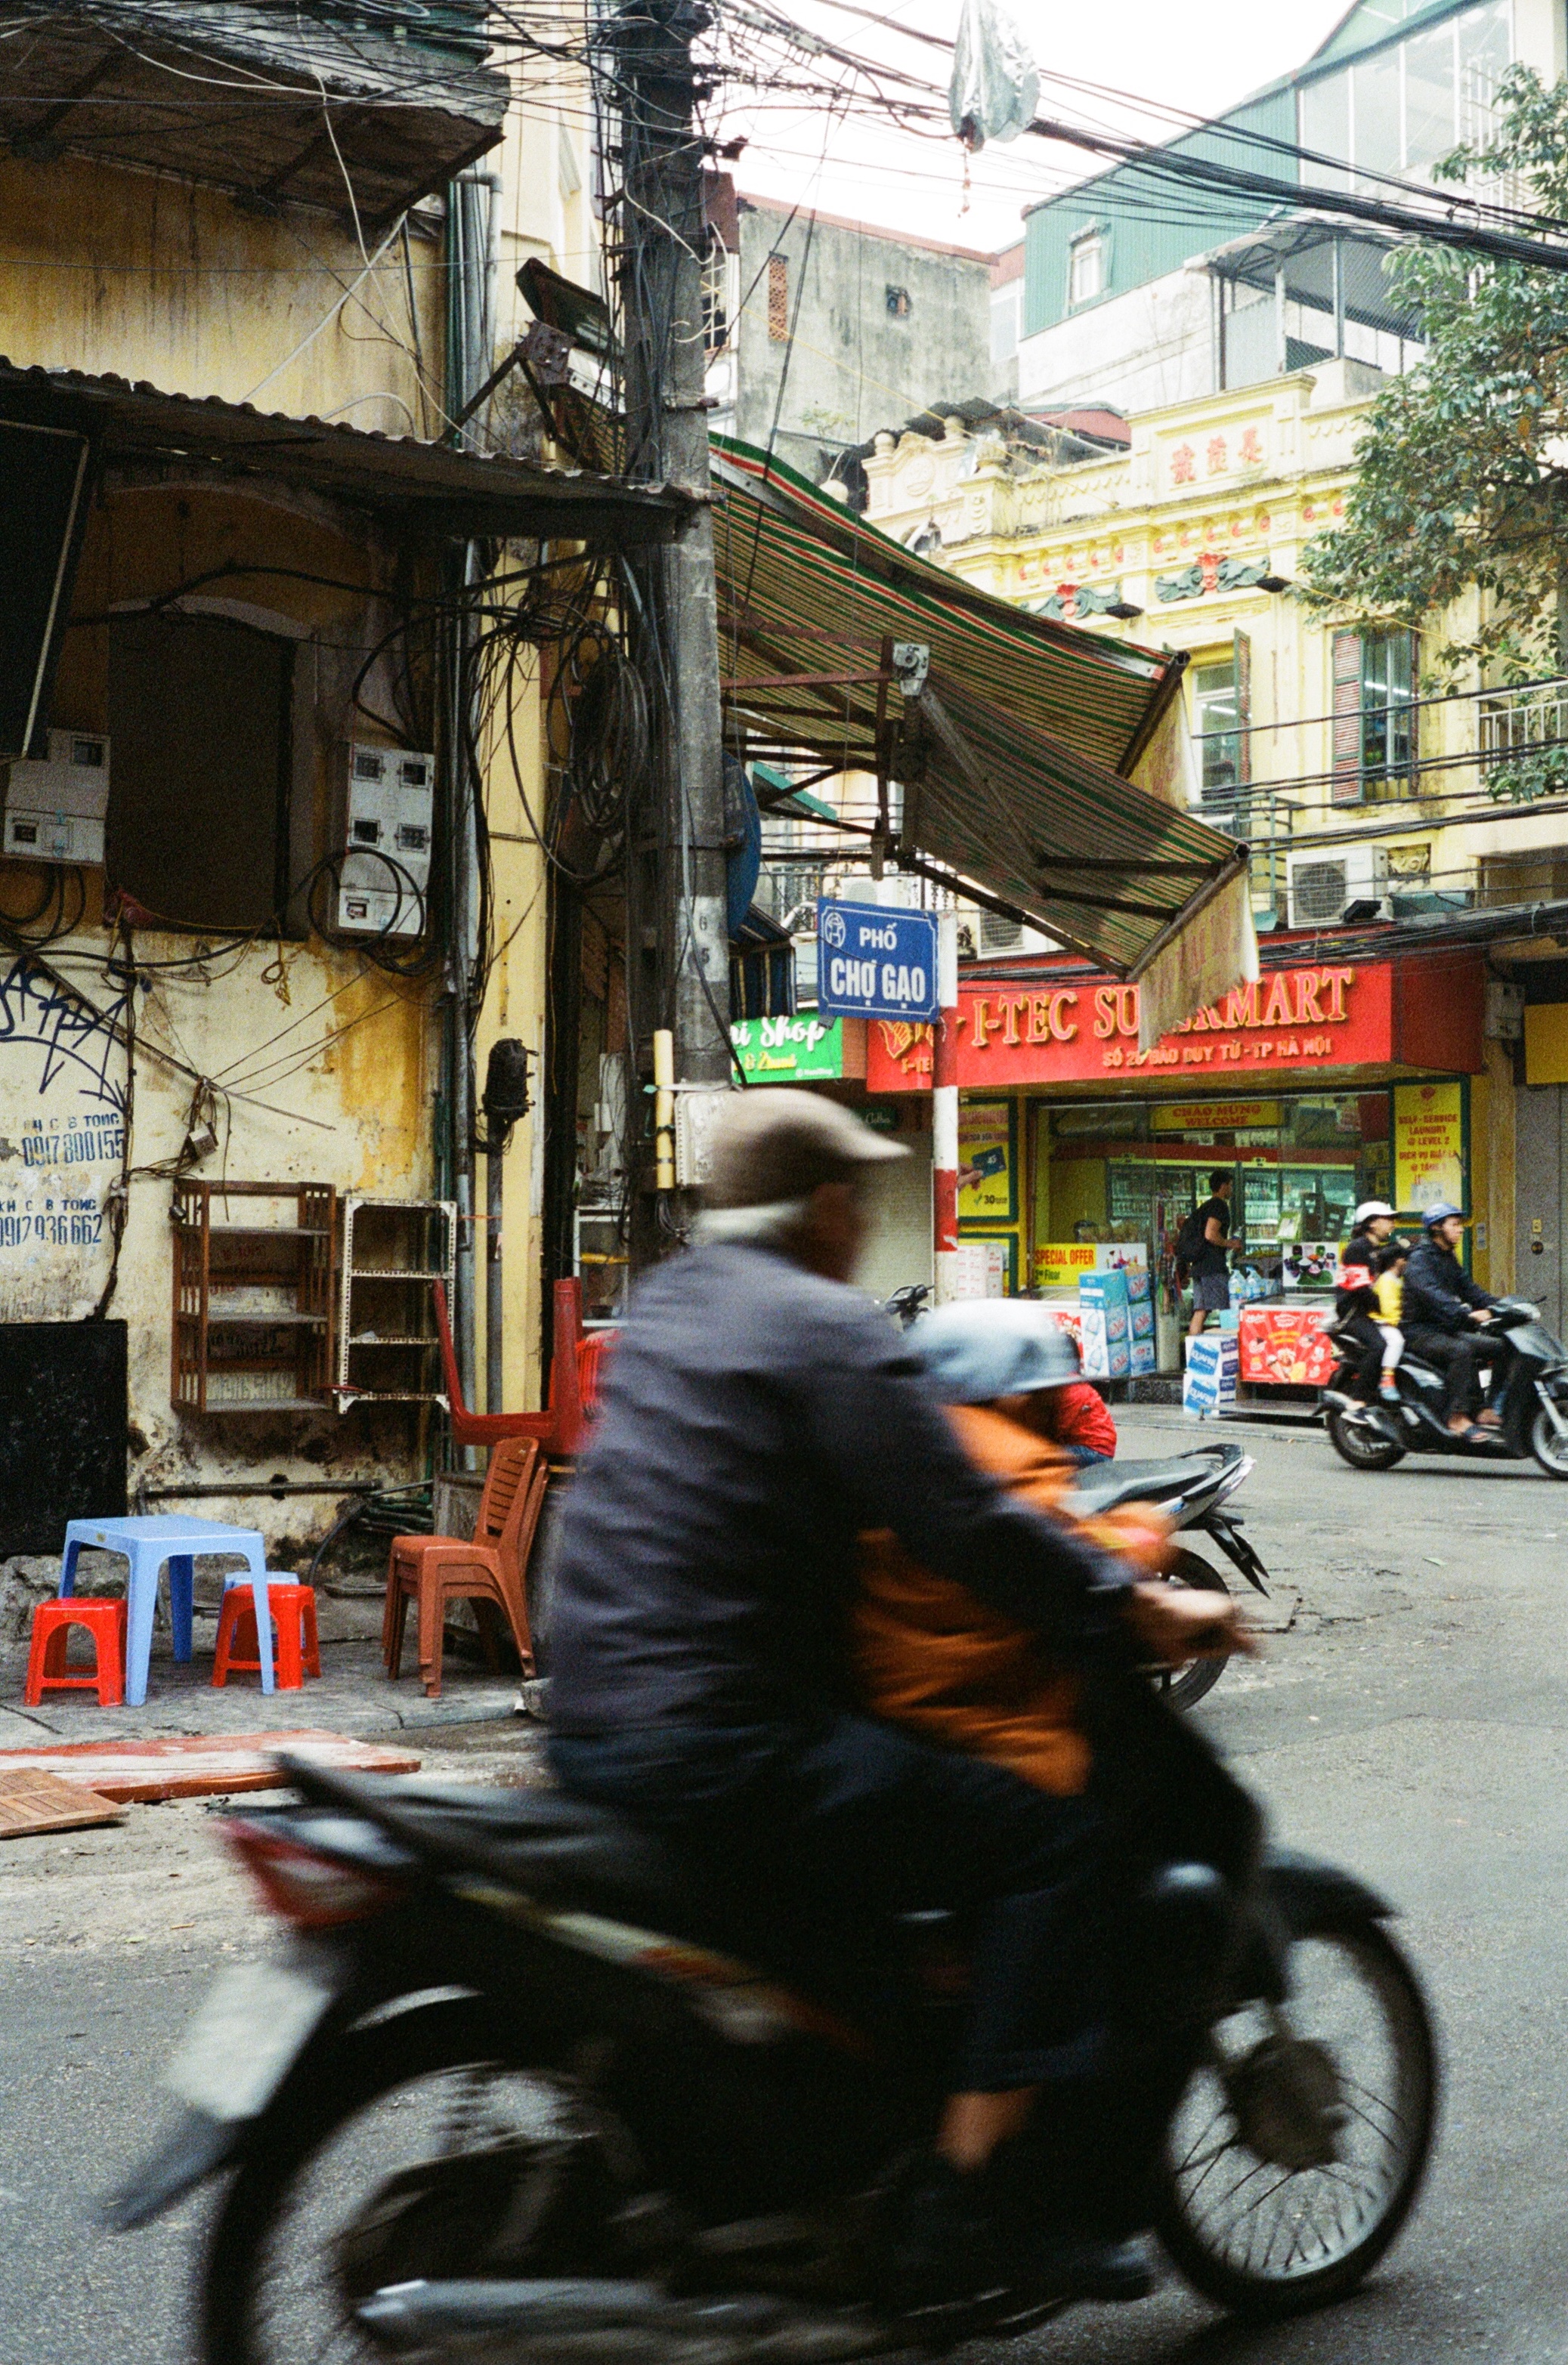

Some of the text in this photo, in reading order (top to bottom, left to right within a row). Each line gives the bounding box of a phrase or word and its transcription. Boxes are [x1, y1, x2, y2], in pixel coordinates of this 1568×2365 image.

[859, 923, 898, 951] PHỐ
[831, 958, 926, 1009] CHỢ GẠO
[1094, 966, 1353, 1038] SUMART
[760, 1015, 825, 1052] Shop
[1277, 1036, 1299, 1056] HÀ
[1304, 1035, 1331, 1057] NỘI
[1035, 1248, 1094, 1265] SPECIAL OFFER
